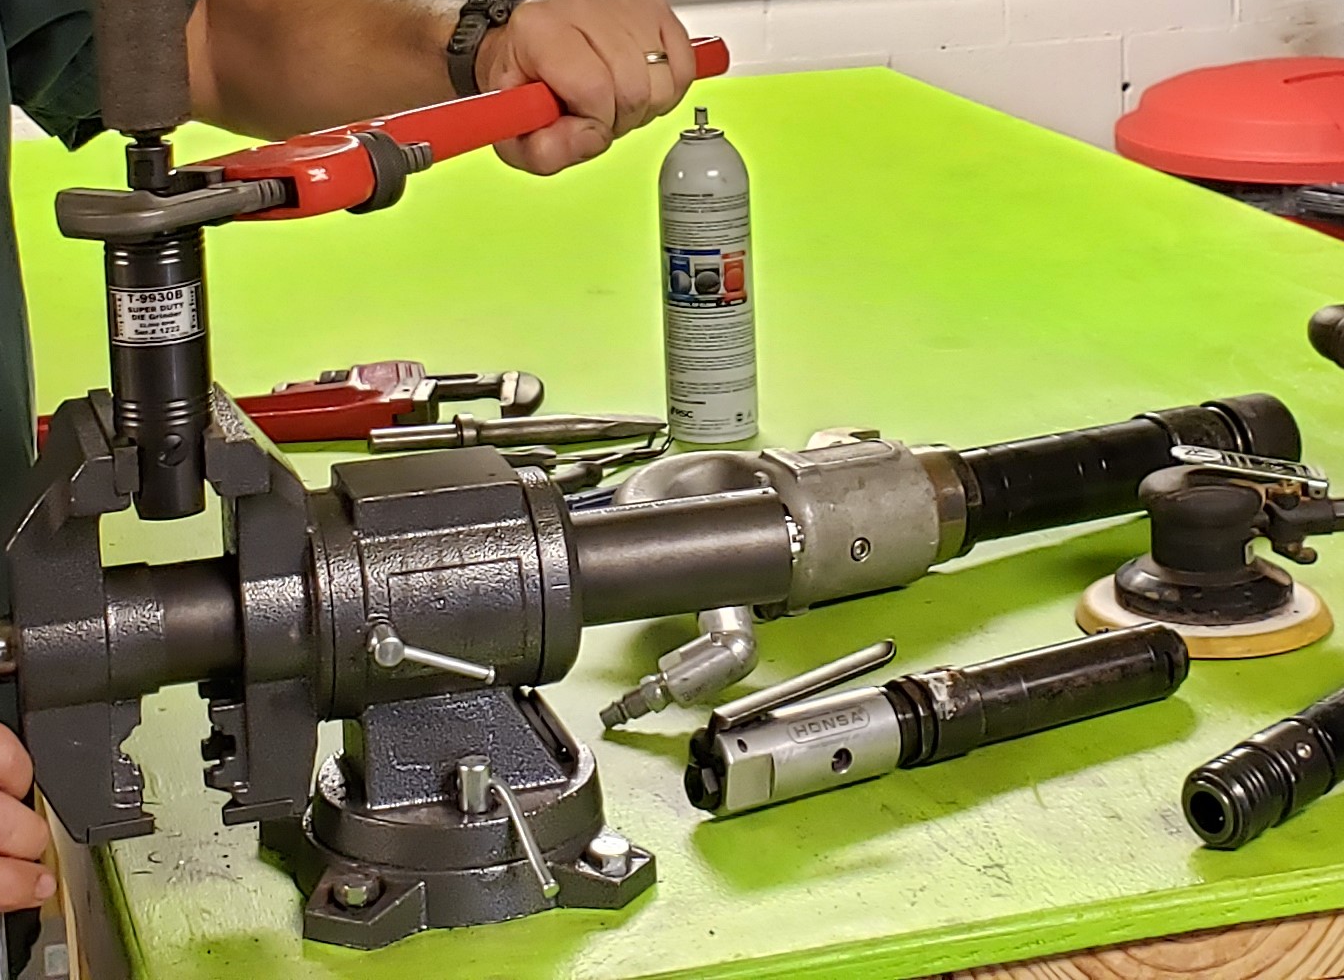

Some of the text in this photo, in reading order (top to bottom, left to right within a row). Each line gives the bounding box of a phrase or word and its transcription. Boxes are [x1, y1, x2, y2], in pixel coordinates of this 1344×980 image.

[127, 289, 183, 304] T-9930B
[160, 302, 184, 312] DUTY
[792, 711, 865, 738] HONSA
